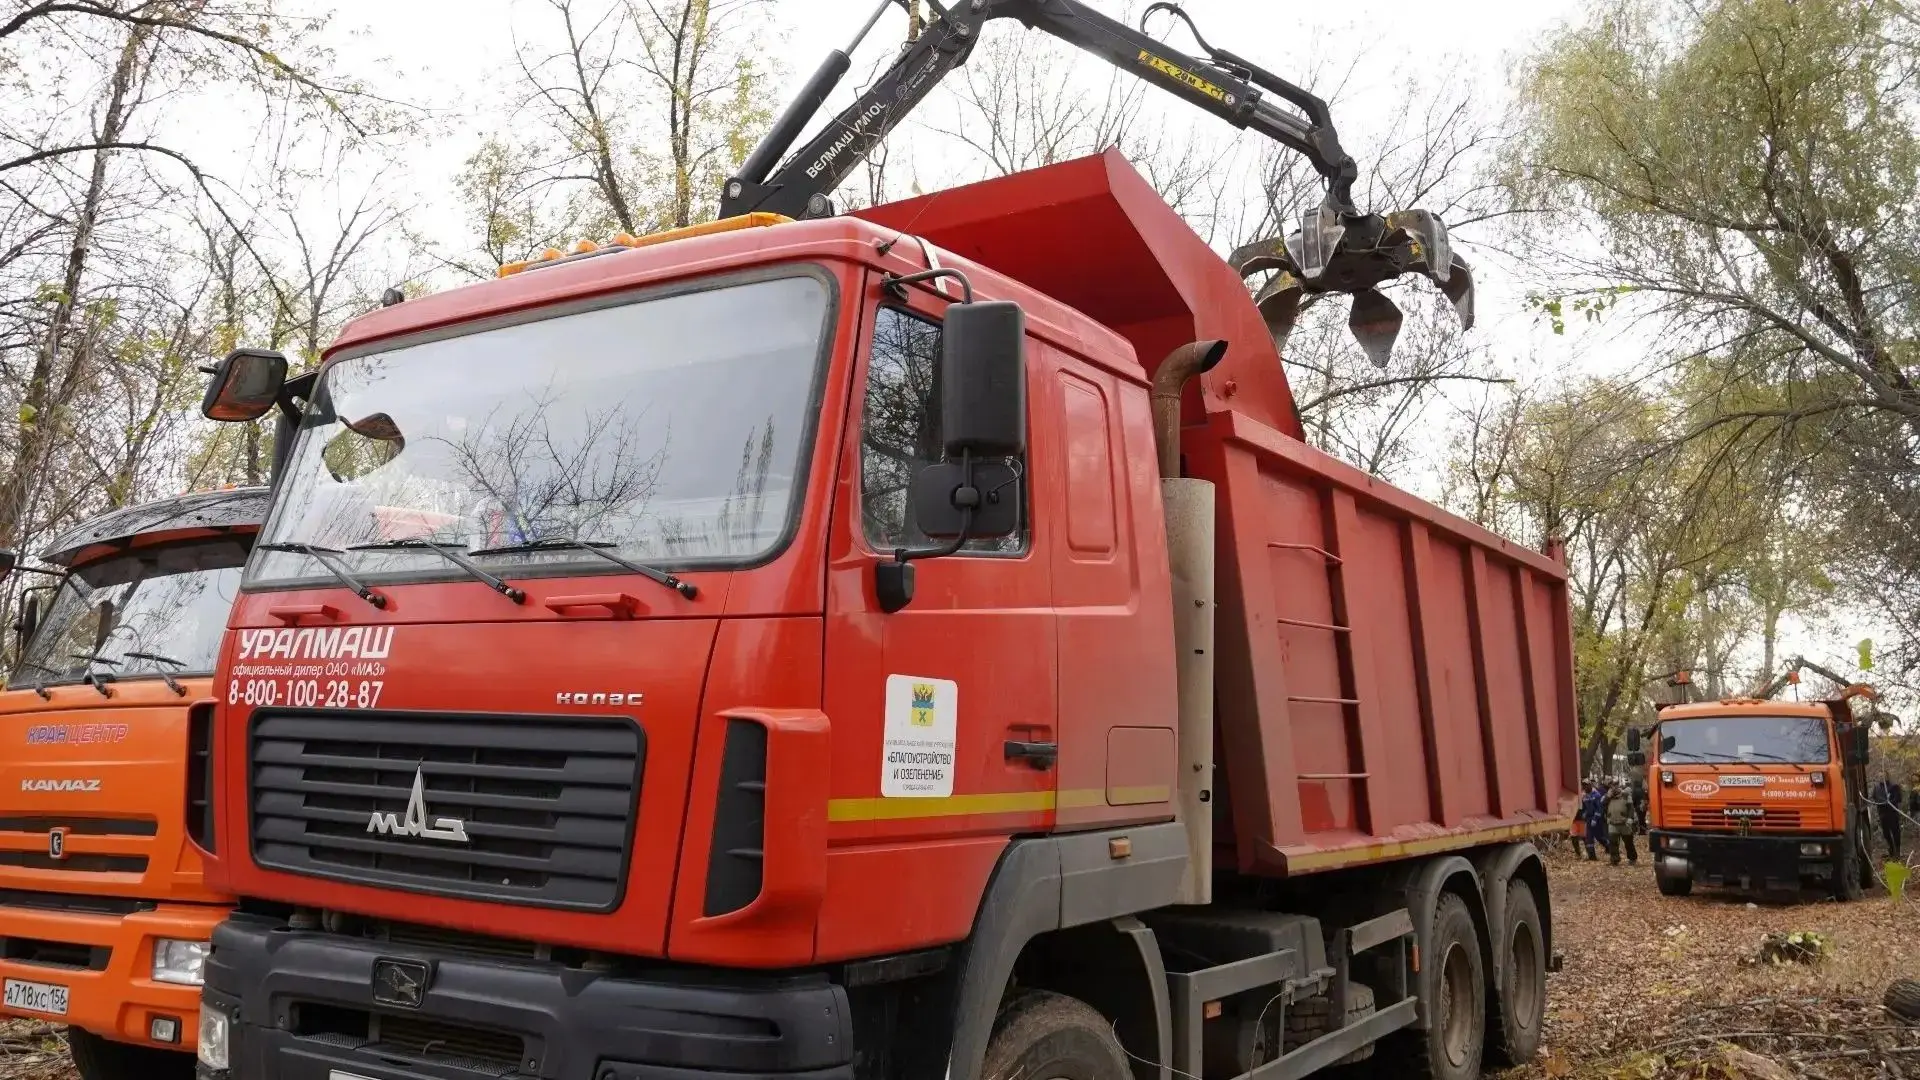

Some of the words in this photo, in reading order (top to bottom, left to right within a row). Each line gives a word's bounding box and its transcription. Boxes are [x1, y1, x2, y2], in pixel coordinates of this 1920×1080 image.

[806, 130, 854, 179] ВЕЛМАШ
[238, 626, 394, 660] УРАЛМАШ
[232, 663, 292, 678] официальный
[293, 664, 324, 678] дилер
[325, 662, 349, 677] ОАО
[350, 663, 386, 677] «МАЗ»
[228, 679, 384, 709] 8-800-100-28-87
[893, 768, 899, 780] И
[21, 779, 101, 792] KAMAZ
[1723, 808, 1765, 816] KAMAZ
